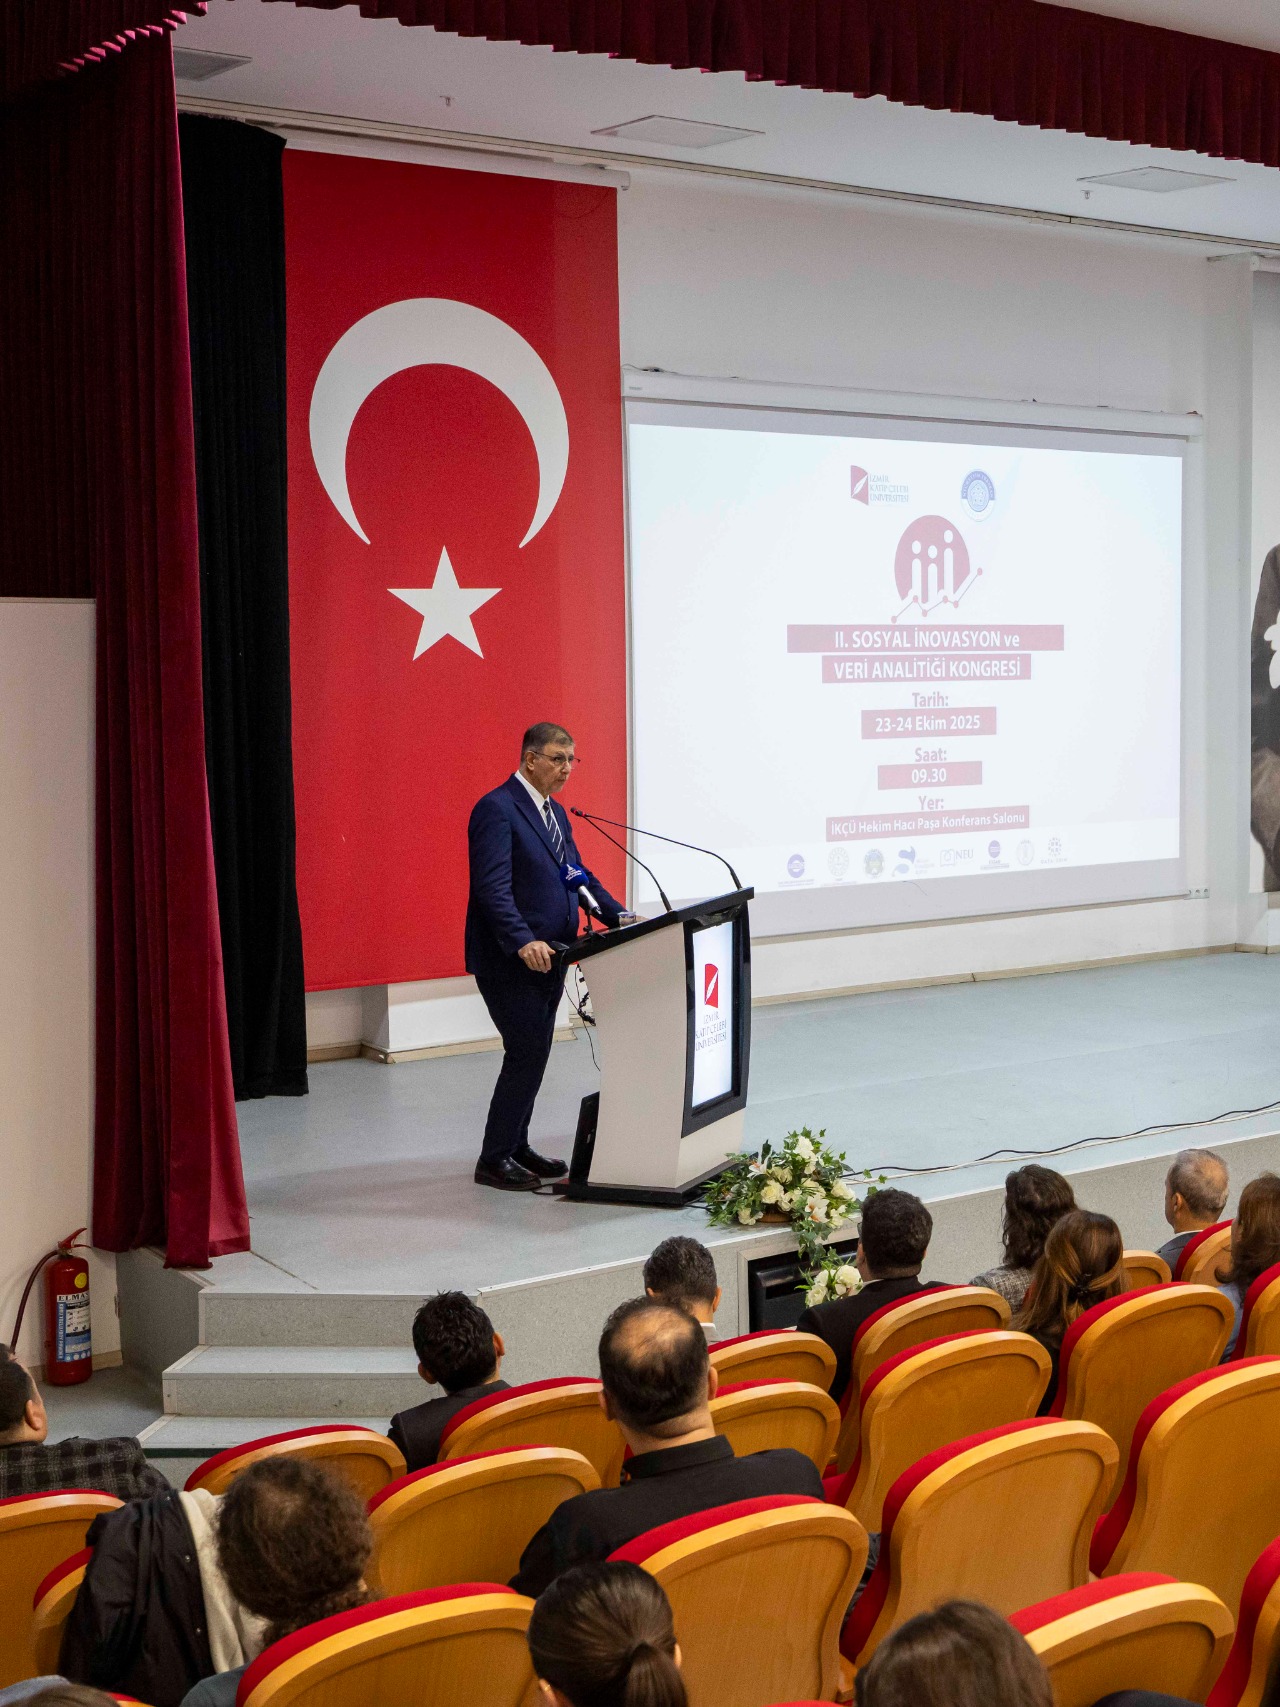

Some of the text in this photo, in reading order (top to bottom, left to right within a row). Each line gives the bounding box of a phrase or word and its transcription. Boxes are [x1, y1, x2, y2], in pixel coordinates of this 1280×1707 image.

[835, 628, 1020, 648] II. SOSYAL İNOVASYON ve
[834, 657, 1021, 679] VERİ ANALİTİĞİ KONGRESİ
[912, 692, 948, 707] Tarih:
[876, 715, 980, 732] 23-24 Ekim 2025
[915, 747, 947, 762] Saat:
[912, 768, 947, 783] 09.30
[919, 796, 944, 810] Yer:
[831, 810, 1025, 837] İKÇÜ Hekim Hacı Paşa Konferans Salonu
